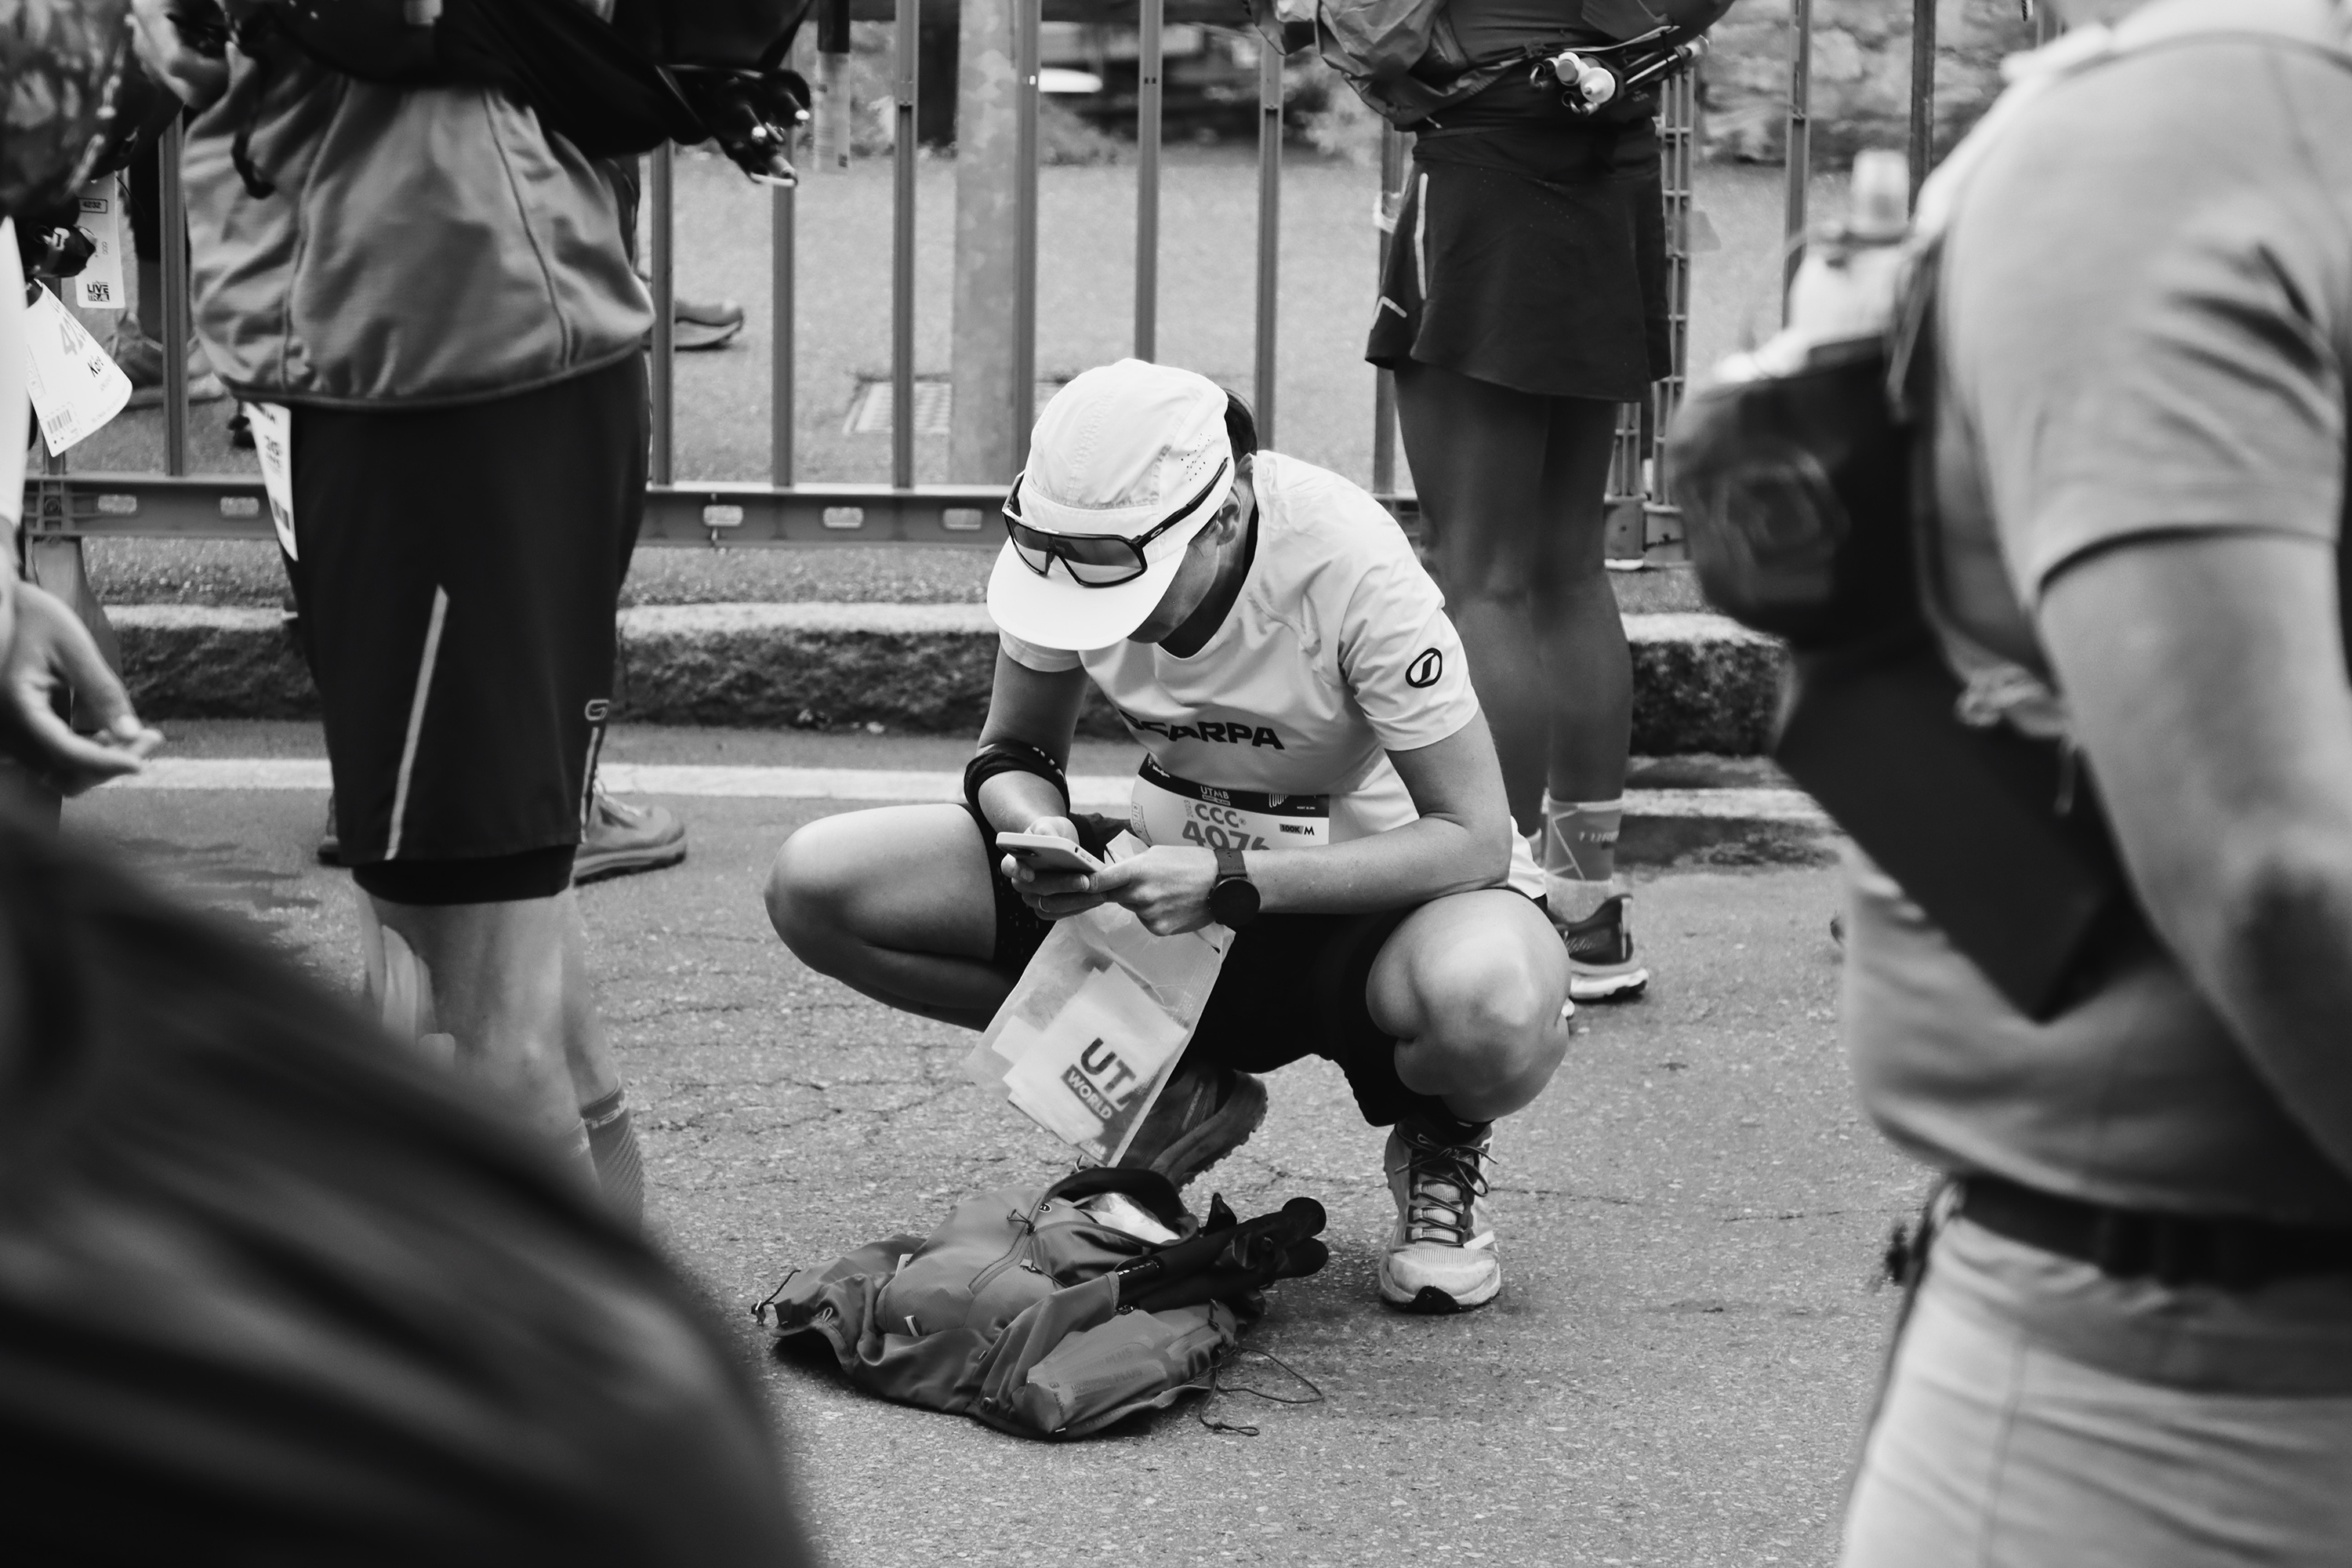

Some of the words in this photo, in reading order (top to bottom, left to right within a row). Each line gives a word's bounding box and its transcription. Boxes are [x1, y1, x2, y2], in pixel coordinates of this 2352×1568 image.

[86, 283, 110, 294] LIVE
[1200, 785, 1229, 800] UTMB
[1281, 824, 1301, 833] 100K
[1304, 826, 1316, 836] M
[1067, 1069, 1112, 1120] WORLD
